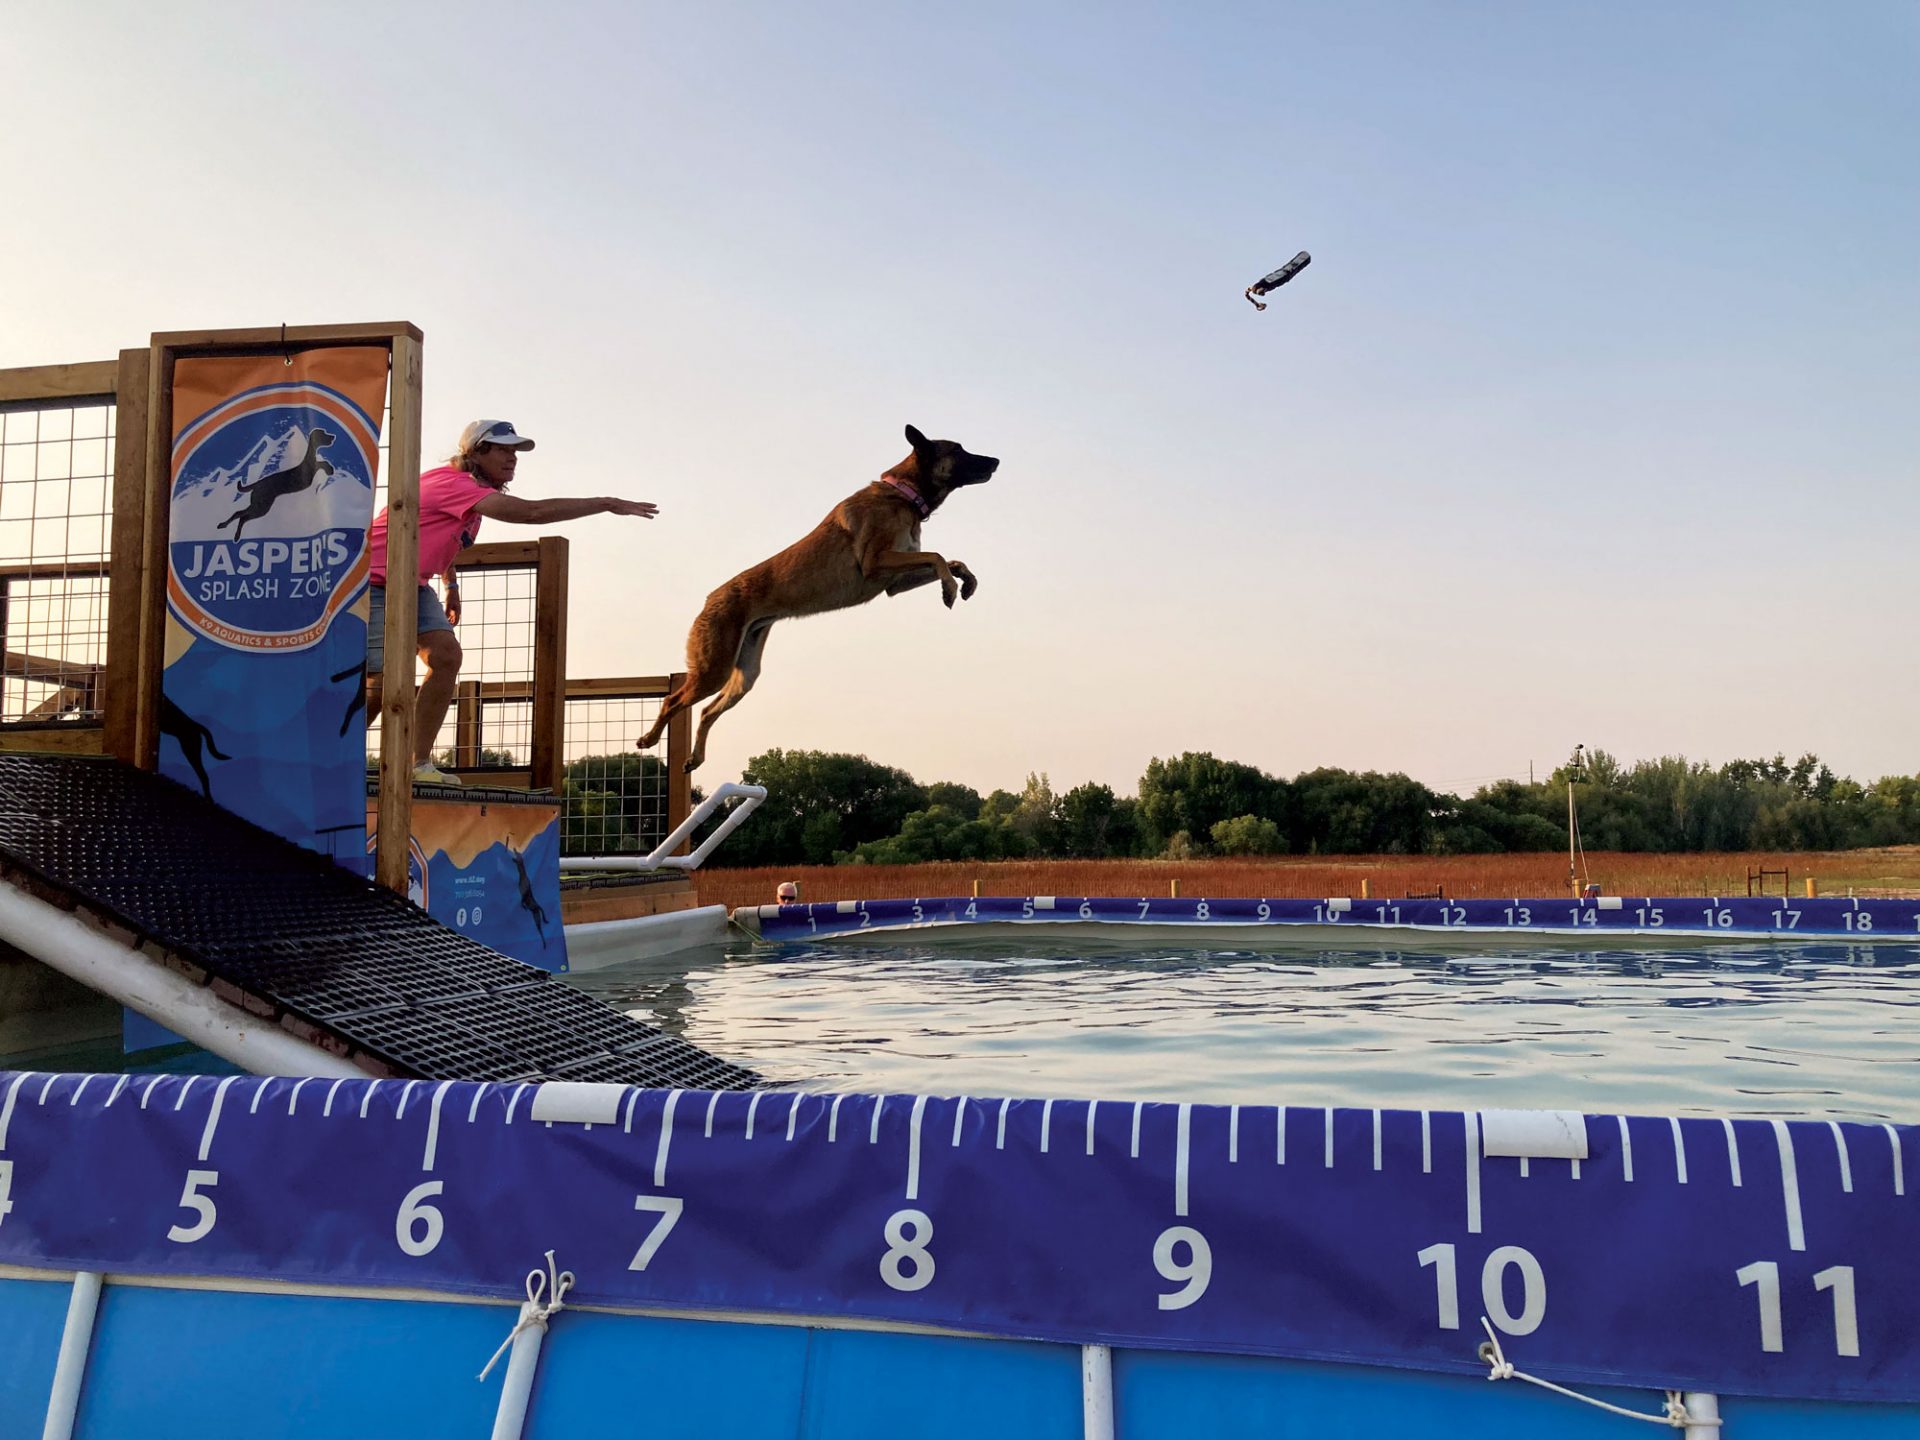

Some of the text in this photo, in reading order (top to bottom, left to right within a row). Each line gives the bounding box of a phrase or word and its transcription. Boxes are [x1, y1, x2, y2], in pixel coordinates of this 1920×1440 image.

[183, 532, 349, 578] JASPER'S
[200, 571, 331, 602] SPLASH ZONE
[199, 617, 315, 647] K9 AQUATICS & SPORTS
[808, 917, 817, 932] 1
[859, 911, 871, 927] 2
[912, 906, 923, 921] 3
[965, 902, 978, 919] 4
[1022, 902, 1034, 919] 5
[1079, 902, 1092, 919] 6
[1137, 902, 1149, 919] 7
[1196, 902, 1210, 920] 8
[1257, 903, 1271, 922] 9
[1313, 905, 1340, 922] 10
[1376, 906, 1401, 924] 11
[1440, 907, 1467, 926] 12
[1503, 907, 1531, 926] 13
[1569, 908, 1598, 926] 14
[1635, 908, 1664, 927] 15
[1703, 908, 1733, 928] 16
[1771, 910, 1802, 929] 17
[1842, 912, 1873, 931] 18
[167, 1169, 1860, 1357] 5 6 7 8 9 10 11
